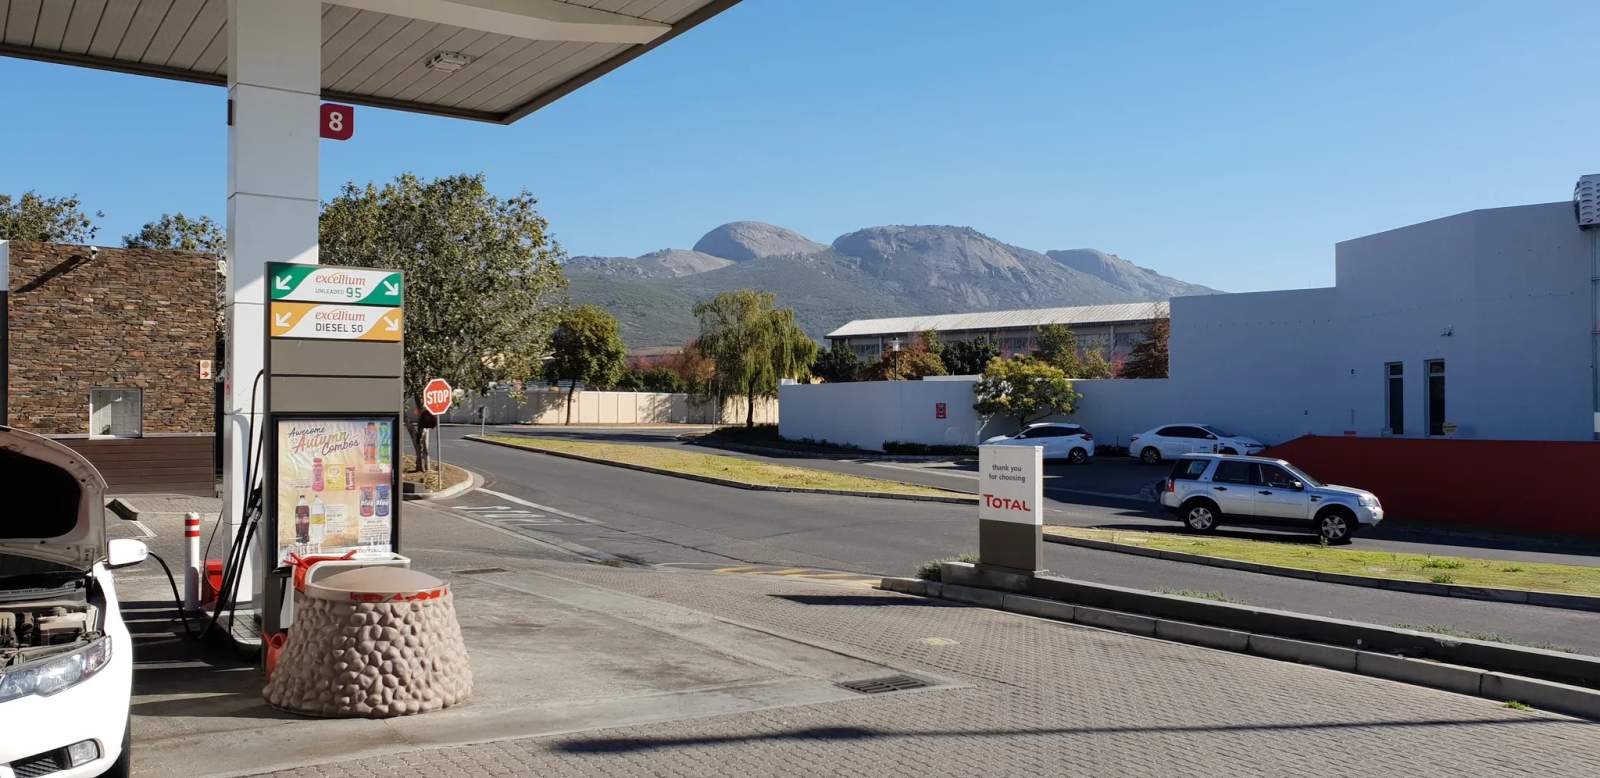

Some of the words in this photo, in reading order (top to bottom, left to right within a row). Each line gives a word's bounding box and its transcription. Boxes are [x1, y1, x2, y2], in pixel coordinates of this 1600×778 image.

[329, 111, 343, 132] 8
[315, 272, 366, 286] excellium
[315, 287, 345, 295] UNLEADED
[346, 287, 362, 298] 95
[315, 308, 365, 321] excellium
[315, 322, 348, 333] DIESEL
[351, 324, 364, 333] 50
[427, 389, 449, 405] STOP
[292, 432, 350, 453] Autumn
[321, 439, 361, 455] Combos
[992, 464, 1009, 472] thank
[998, 474, 1026, 483] choosing
